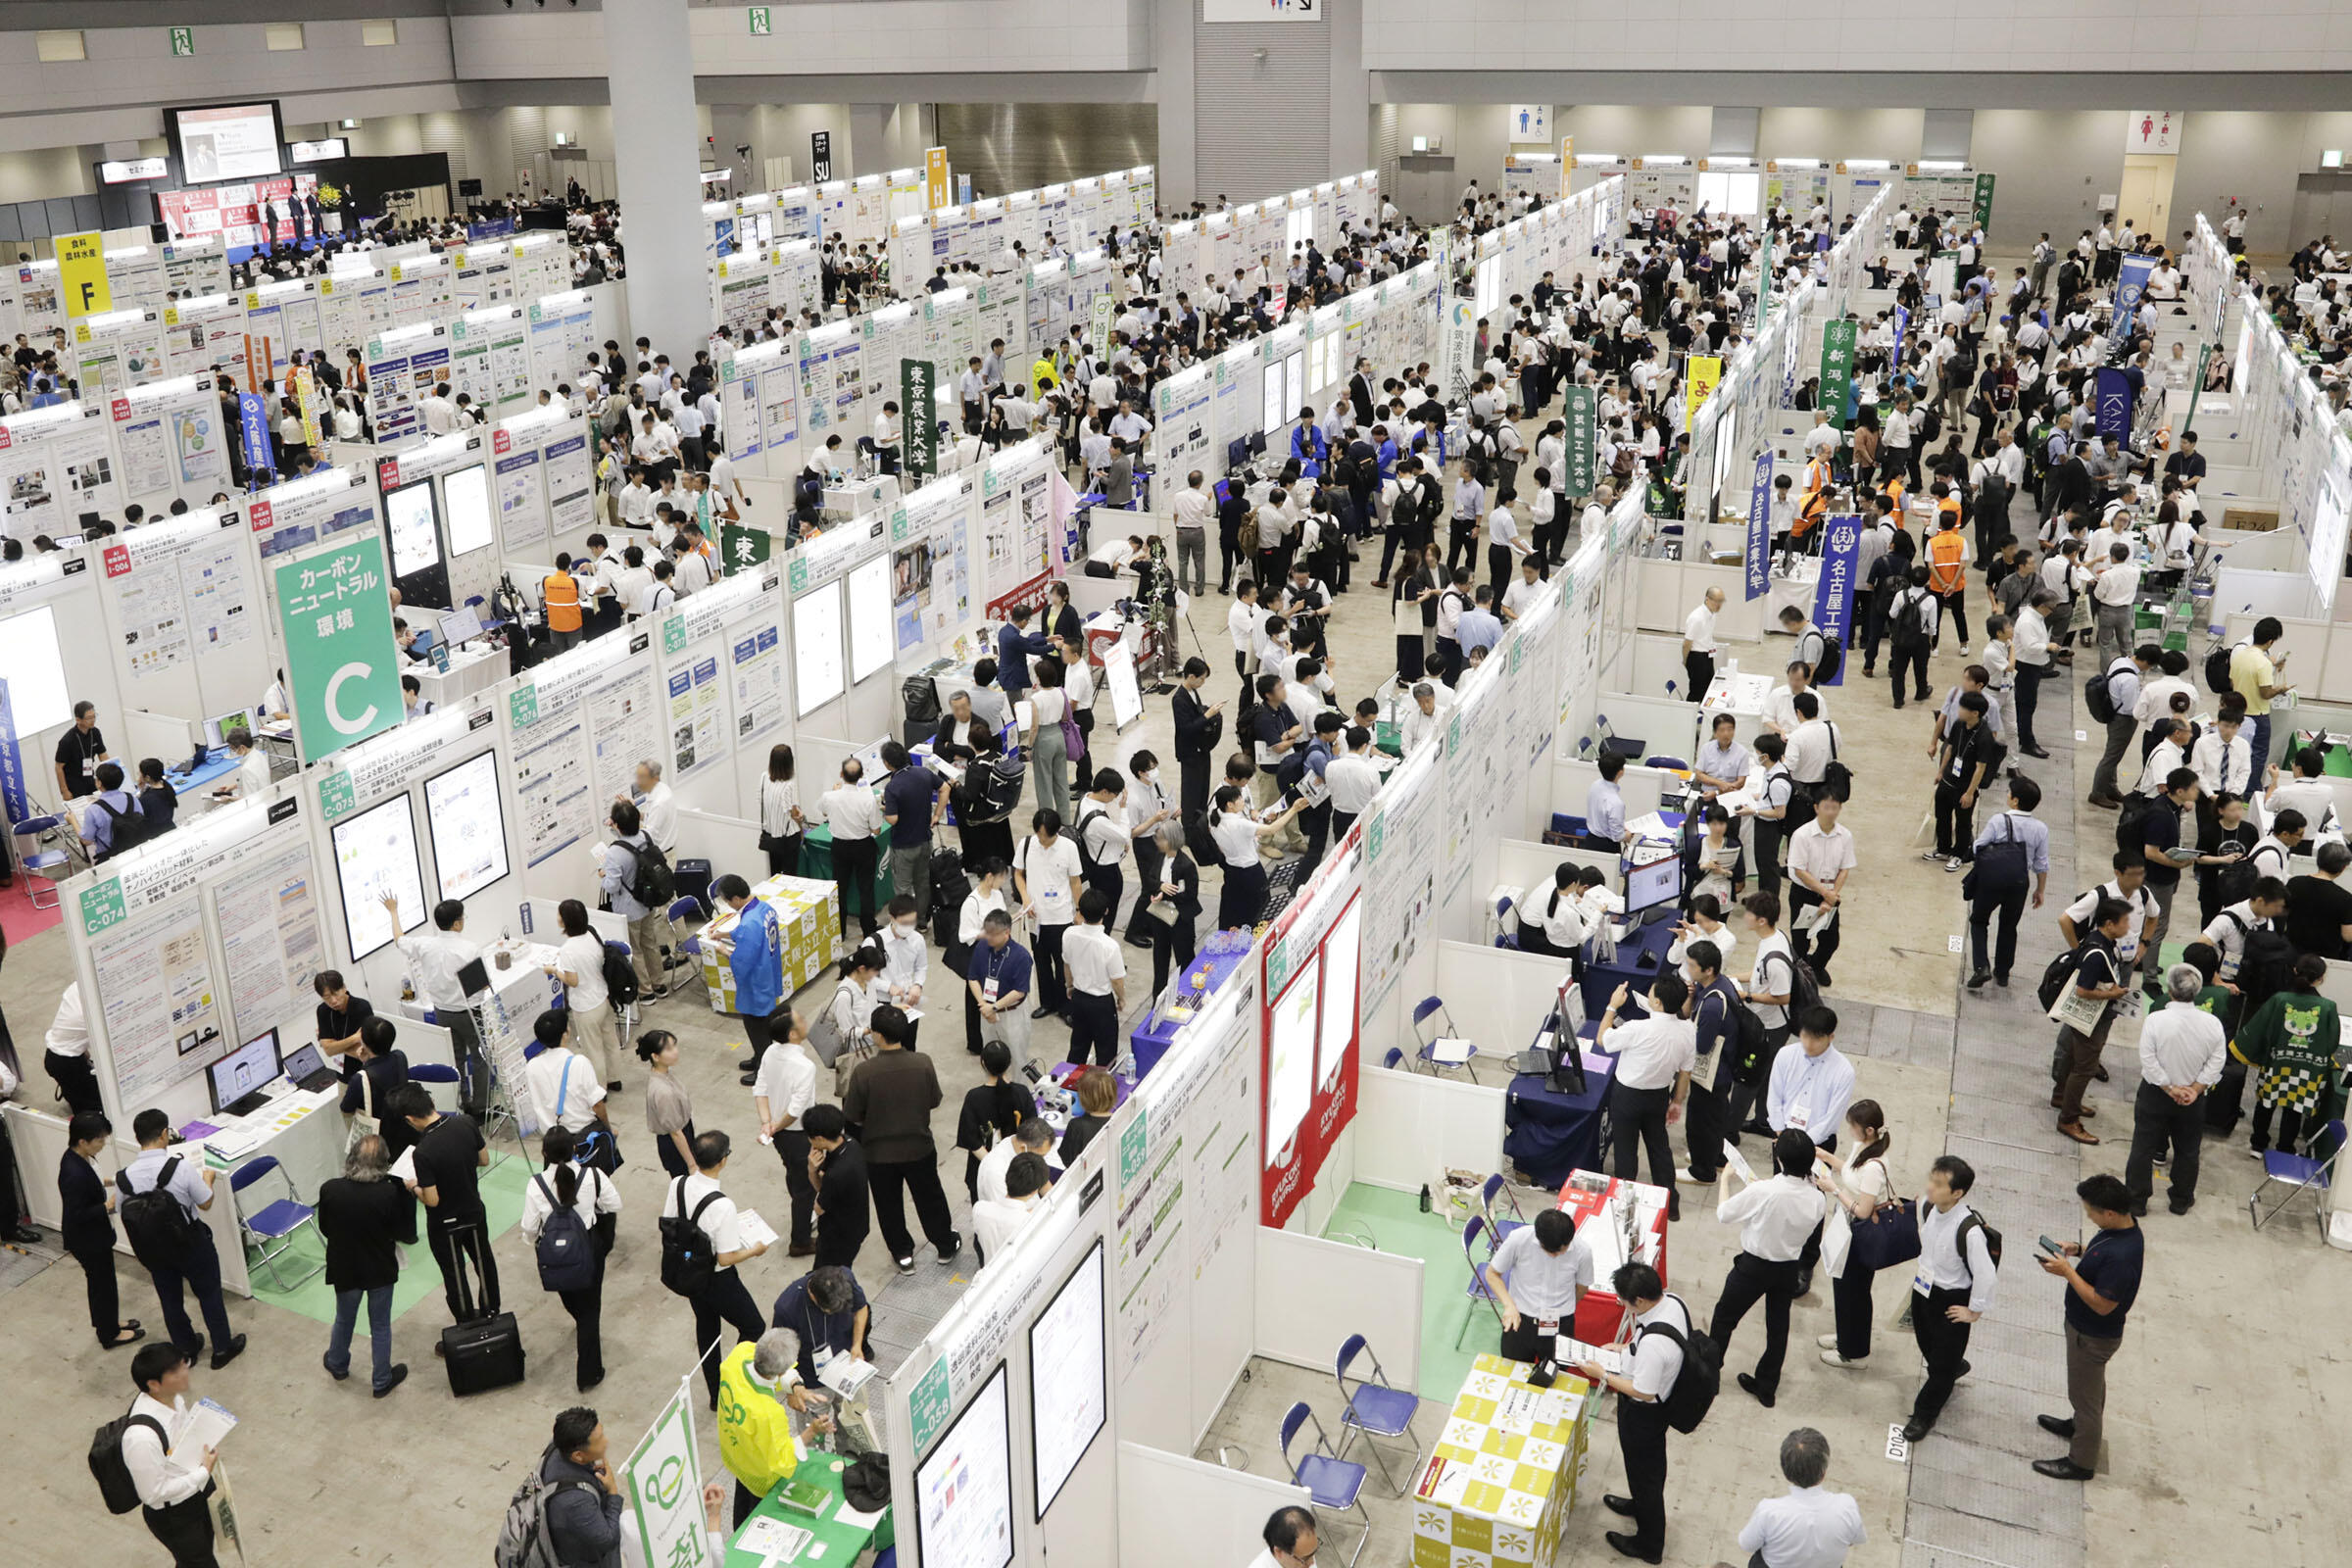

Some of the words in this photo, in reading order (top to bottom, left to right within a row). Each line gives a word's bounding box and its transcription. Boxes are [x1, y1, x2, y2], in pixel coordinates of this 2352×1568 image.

[815, 161, 830, 182] SU
[933, 183, 943, 207] H
[80, 282, 95, 311] F
[909, 366, 928, 467] 東京農業大学
[254, 517, 270, 528] I-007
[108, 562, 129, 573] I-006
[300, 554, 362, 590] カーボン
[289, 570, 378, 615] ニュートラル
[316, 608, 355, 638] 環境
[665, 638, 685, 653] C-077
[324, 662, 378, 735] C
[513, 711, 537, 727] C-076
[321, 780, 350, 798] ニュートラル
[324, 774, 345, 788] カーボン
[324, 797, 354, 818] C-075
[84, 888, 120, 909] ニュートラル
[87, 882, 113, 900] カーボン
[87, 906, 124, 932] C-074
[1122, 1147, 1146, 1185] C-059
[912, 1372, 947, 1417] ニュートラル
[916, 1364, 942, 1399] カーボン
[915, 1397, 949, 1448] C-058
[1889, 1426, 1906, 1457] D10-2
